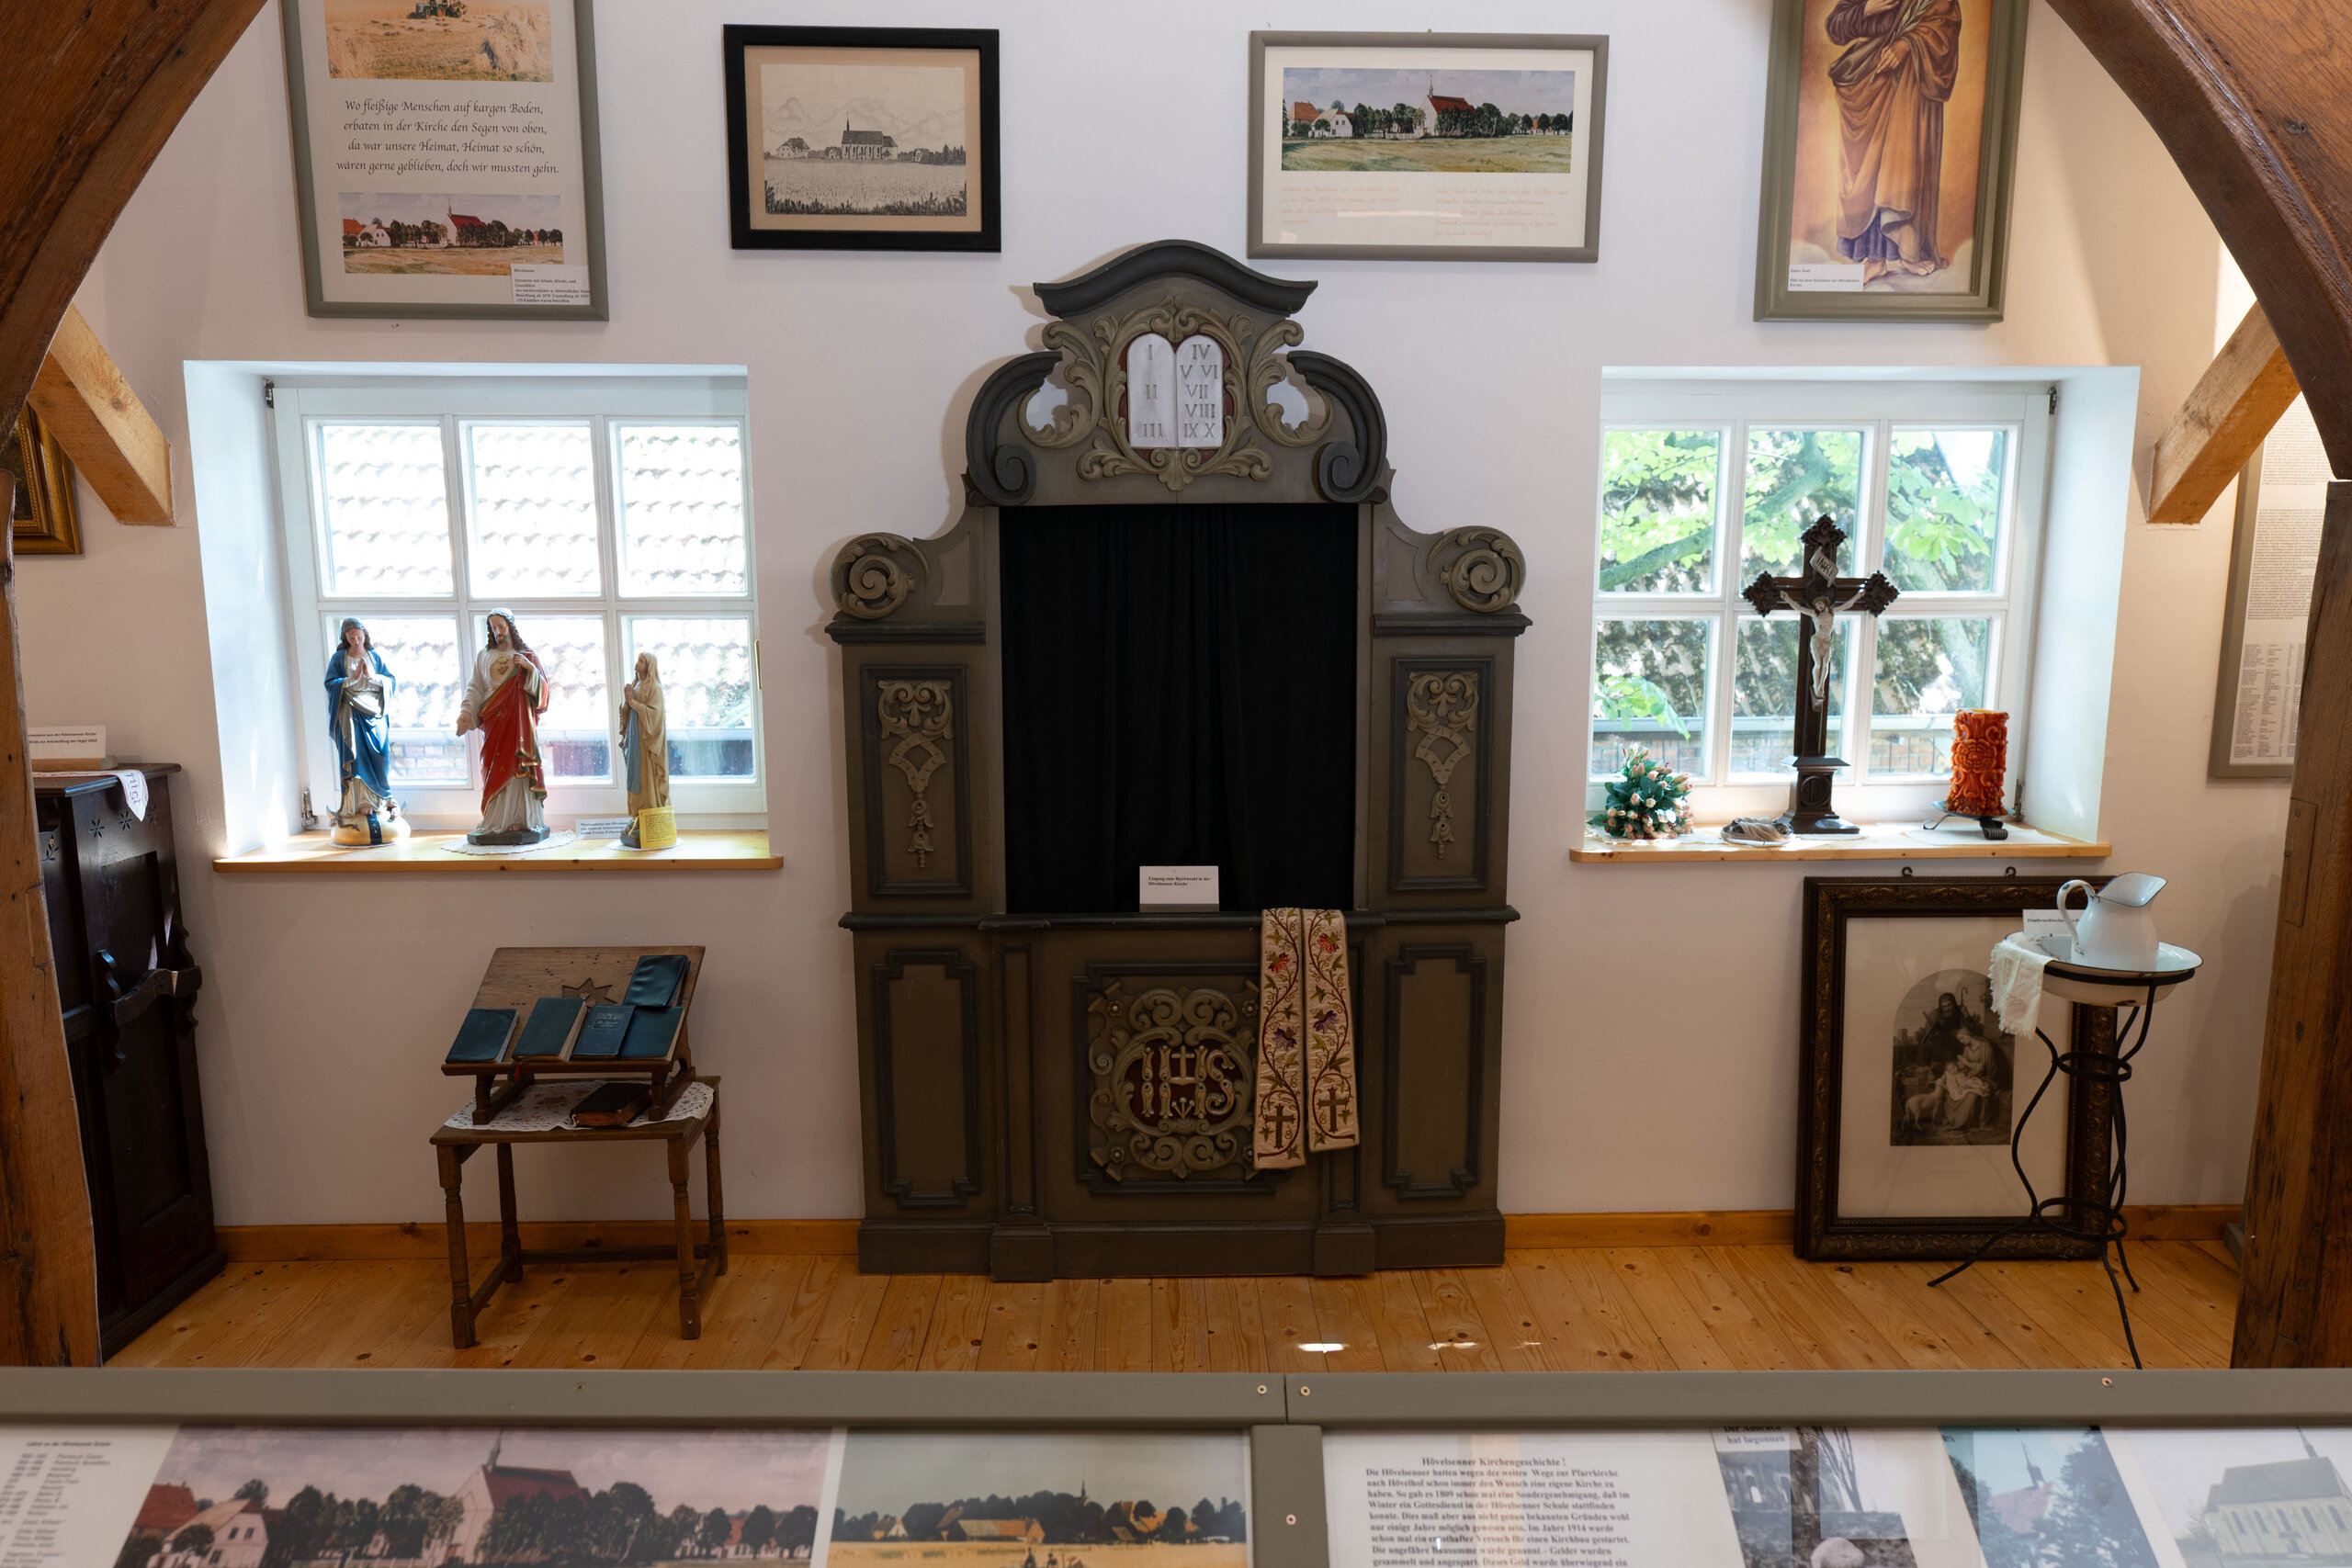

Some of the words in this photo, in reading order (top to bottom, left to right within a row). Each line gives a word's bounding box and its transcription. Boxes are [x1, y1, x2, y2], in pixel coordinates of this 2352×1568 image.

[345, 100, 361, 111] Wo
[361, 98, 399, 116] fleißige
[401, 99, 450, 111] Menschen
[453, 100, 472, 117] auf
[473, 100, 506, 117] kargen
[509, 102, 543, 115] Boden,
[344, 118, 379, 130] erbaten
[383, 121, 393, 130] in
[396, 118, 412, 131] der
[414, 119, 448, 131] Kirche
[450, 120, 469, 132] den
[471, 122, 499, 137] Segen
[522, 121, 547, 135] oben,
[348, 138, 361, 150] da
[419, 139, 459, 152] Heimat,
[461, 140, 500, 152] Heimat
[515, 141, 545, 154] schön,
[336, 161, 367, 170] wären
[368, 163, 395, 175] gerne
[397, 158, 444, 175] geblieben,
[447, 159, 469, 172] doch
[471, 163, 489, 172] wir
[491, 164, 530, 173] mussten
[532, 162, 559, 177] gehn.
[1192, 344, 1212, 360] IV
[1180, 365, 1193, 379] V
[1200, 365, 1218, 379] VI
[1145, 384, 1158, 400] II
[1185, 384, 1208, 400] VII
[1184, 403, 1216, 419] VIII
[1142, 423, 1163, 438] III
[1183, 423, 1199, 438] IX
[1204, 423, 1216, 438] X
[1141, 1044, 1236, 1119] IHS
[1421, 1458, 1476, 1466] Hövelsenner
[1479, 1457, 1560, 1467] Kirchengeschichte
[1532, 1469, 1555, 1478] Wege
[1571, 1469, 1619, 1477] Pfarrkirche
[1548, 1480, 1573, 1488] eigene
[1490, 1501, 1541, 1509] Hövelsenner
[1543, 1501, 1569, 1509] Schule
[1572, 1501, 1615, 1509] stattfinden
[1429, 1535, 1474, 1543] ersthafter
